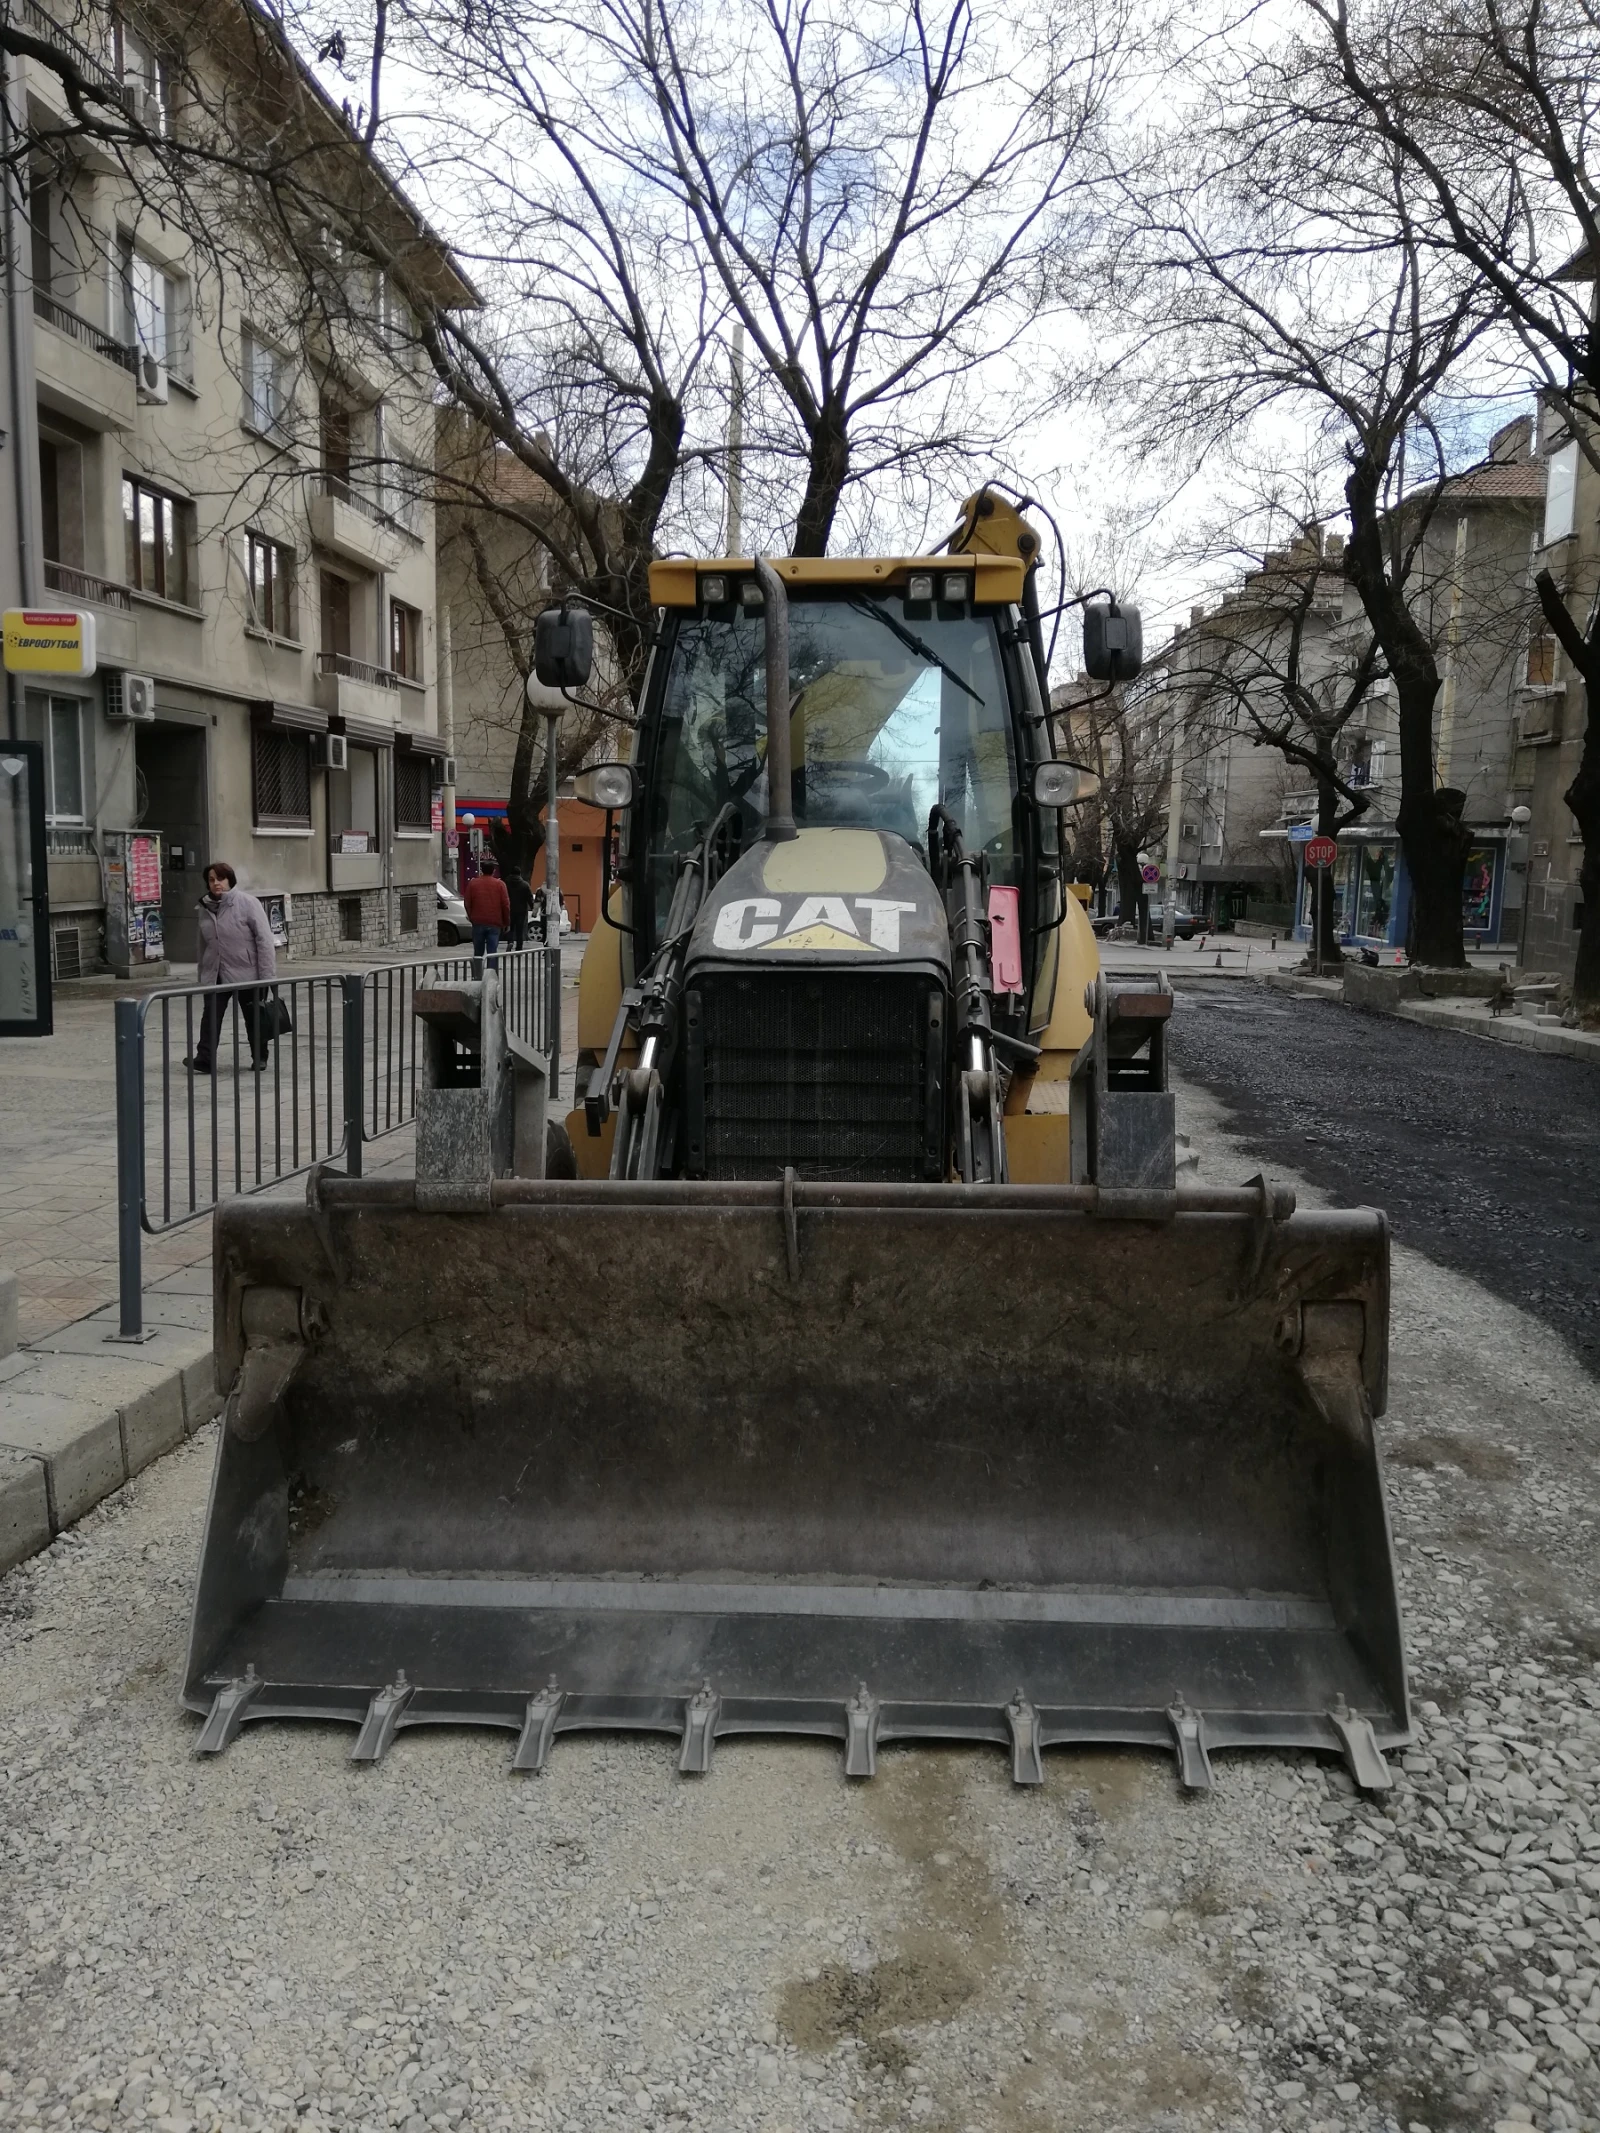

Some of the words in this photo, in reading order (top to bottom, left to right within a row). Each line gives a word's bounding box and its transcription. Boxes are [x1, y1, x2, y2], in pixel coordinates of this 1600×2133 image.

[18, 639, 79, 649] ЕВРОФУТБОЛ
[1309, 846, 1333, 859] STOP
[713, 897, 917, 953] CAT
